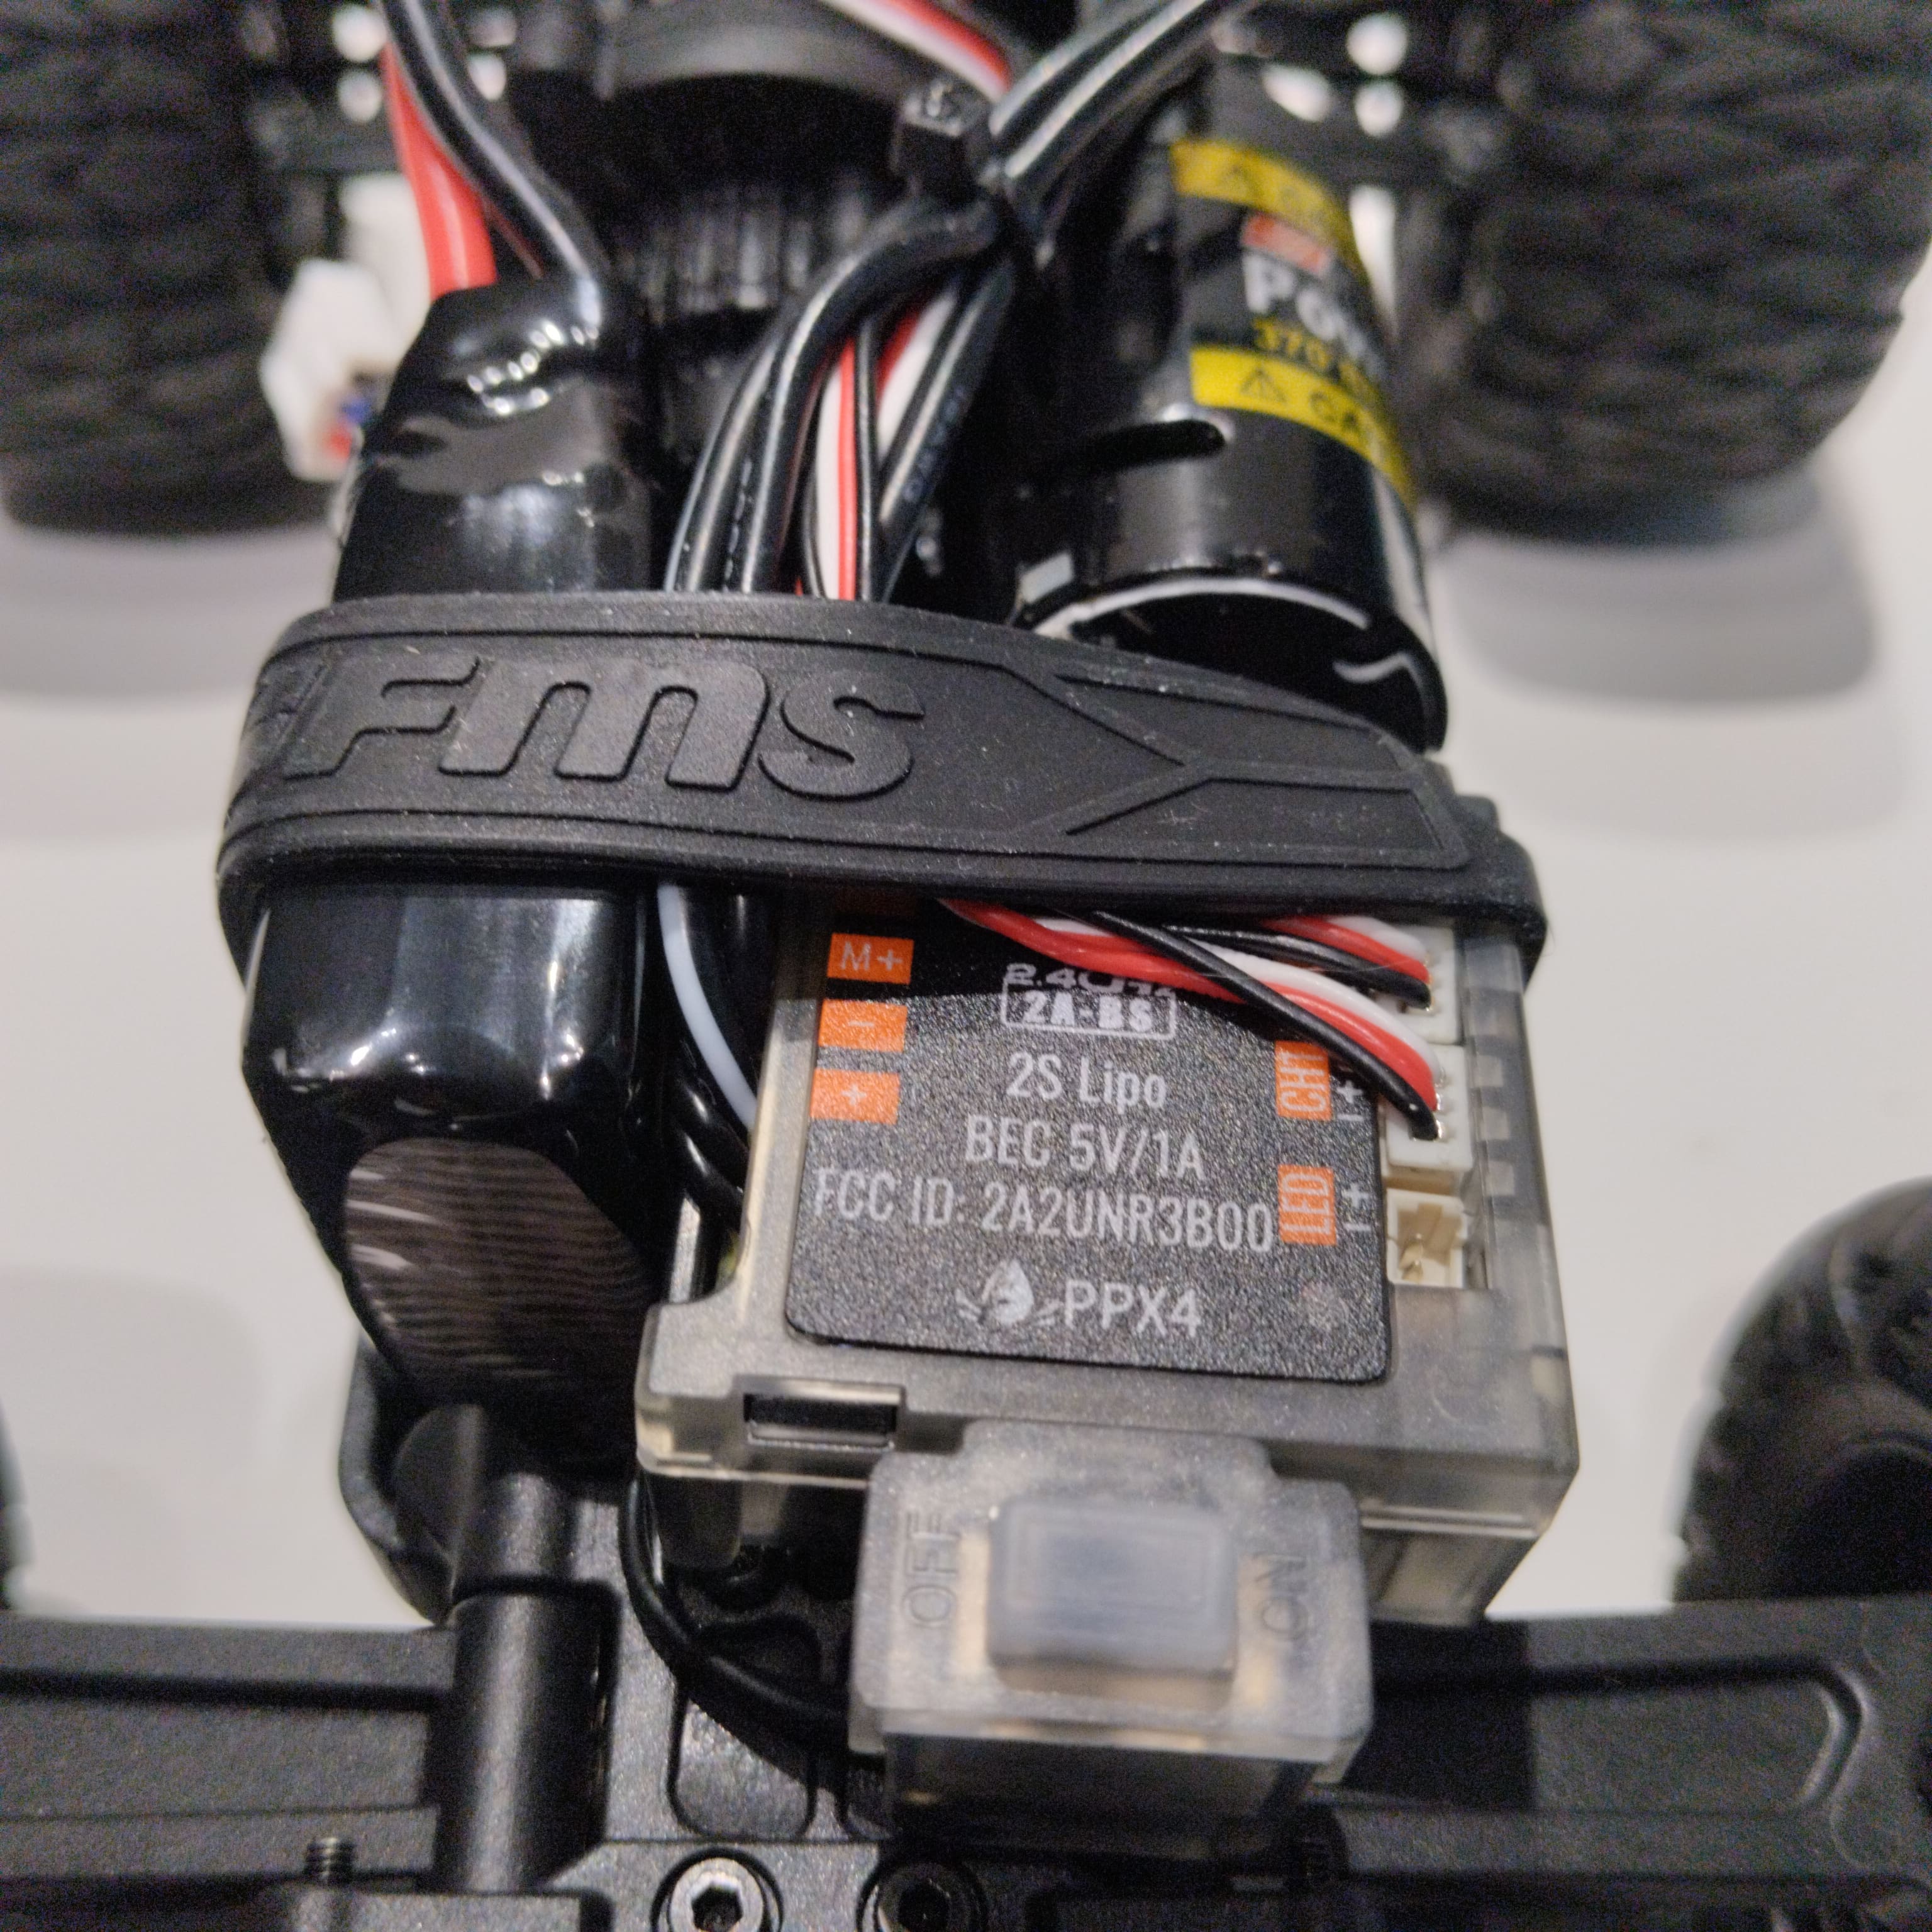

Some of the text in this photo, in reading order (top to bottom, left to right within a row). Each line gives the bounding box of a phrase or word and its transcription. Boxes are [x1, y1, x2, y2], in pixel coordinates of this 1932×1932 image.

[840, 940, 901, 972] M+
[1021, 989, 1153, 1033] 2A-BS
[1006, 1052, 1168, 1115] 2S Lipo
[1280, 1050, 1327, 1112] CH1
[964, 1114, 1204, 1181] BEC 5V/1A
[816, 1167, 1273, 1253] FCC ID: 2A2UNR3B00
[1281, 1173, 1331, 1235] LED
[1064, 1279, 1202, 1338] PPX4
[901, 1511, 961, 1630] OFF
[1252, 1550, 1313, 1644] ON
